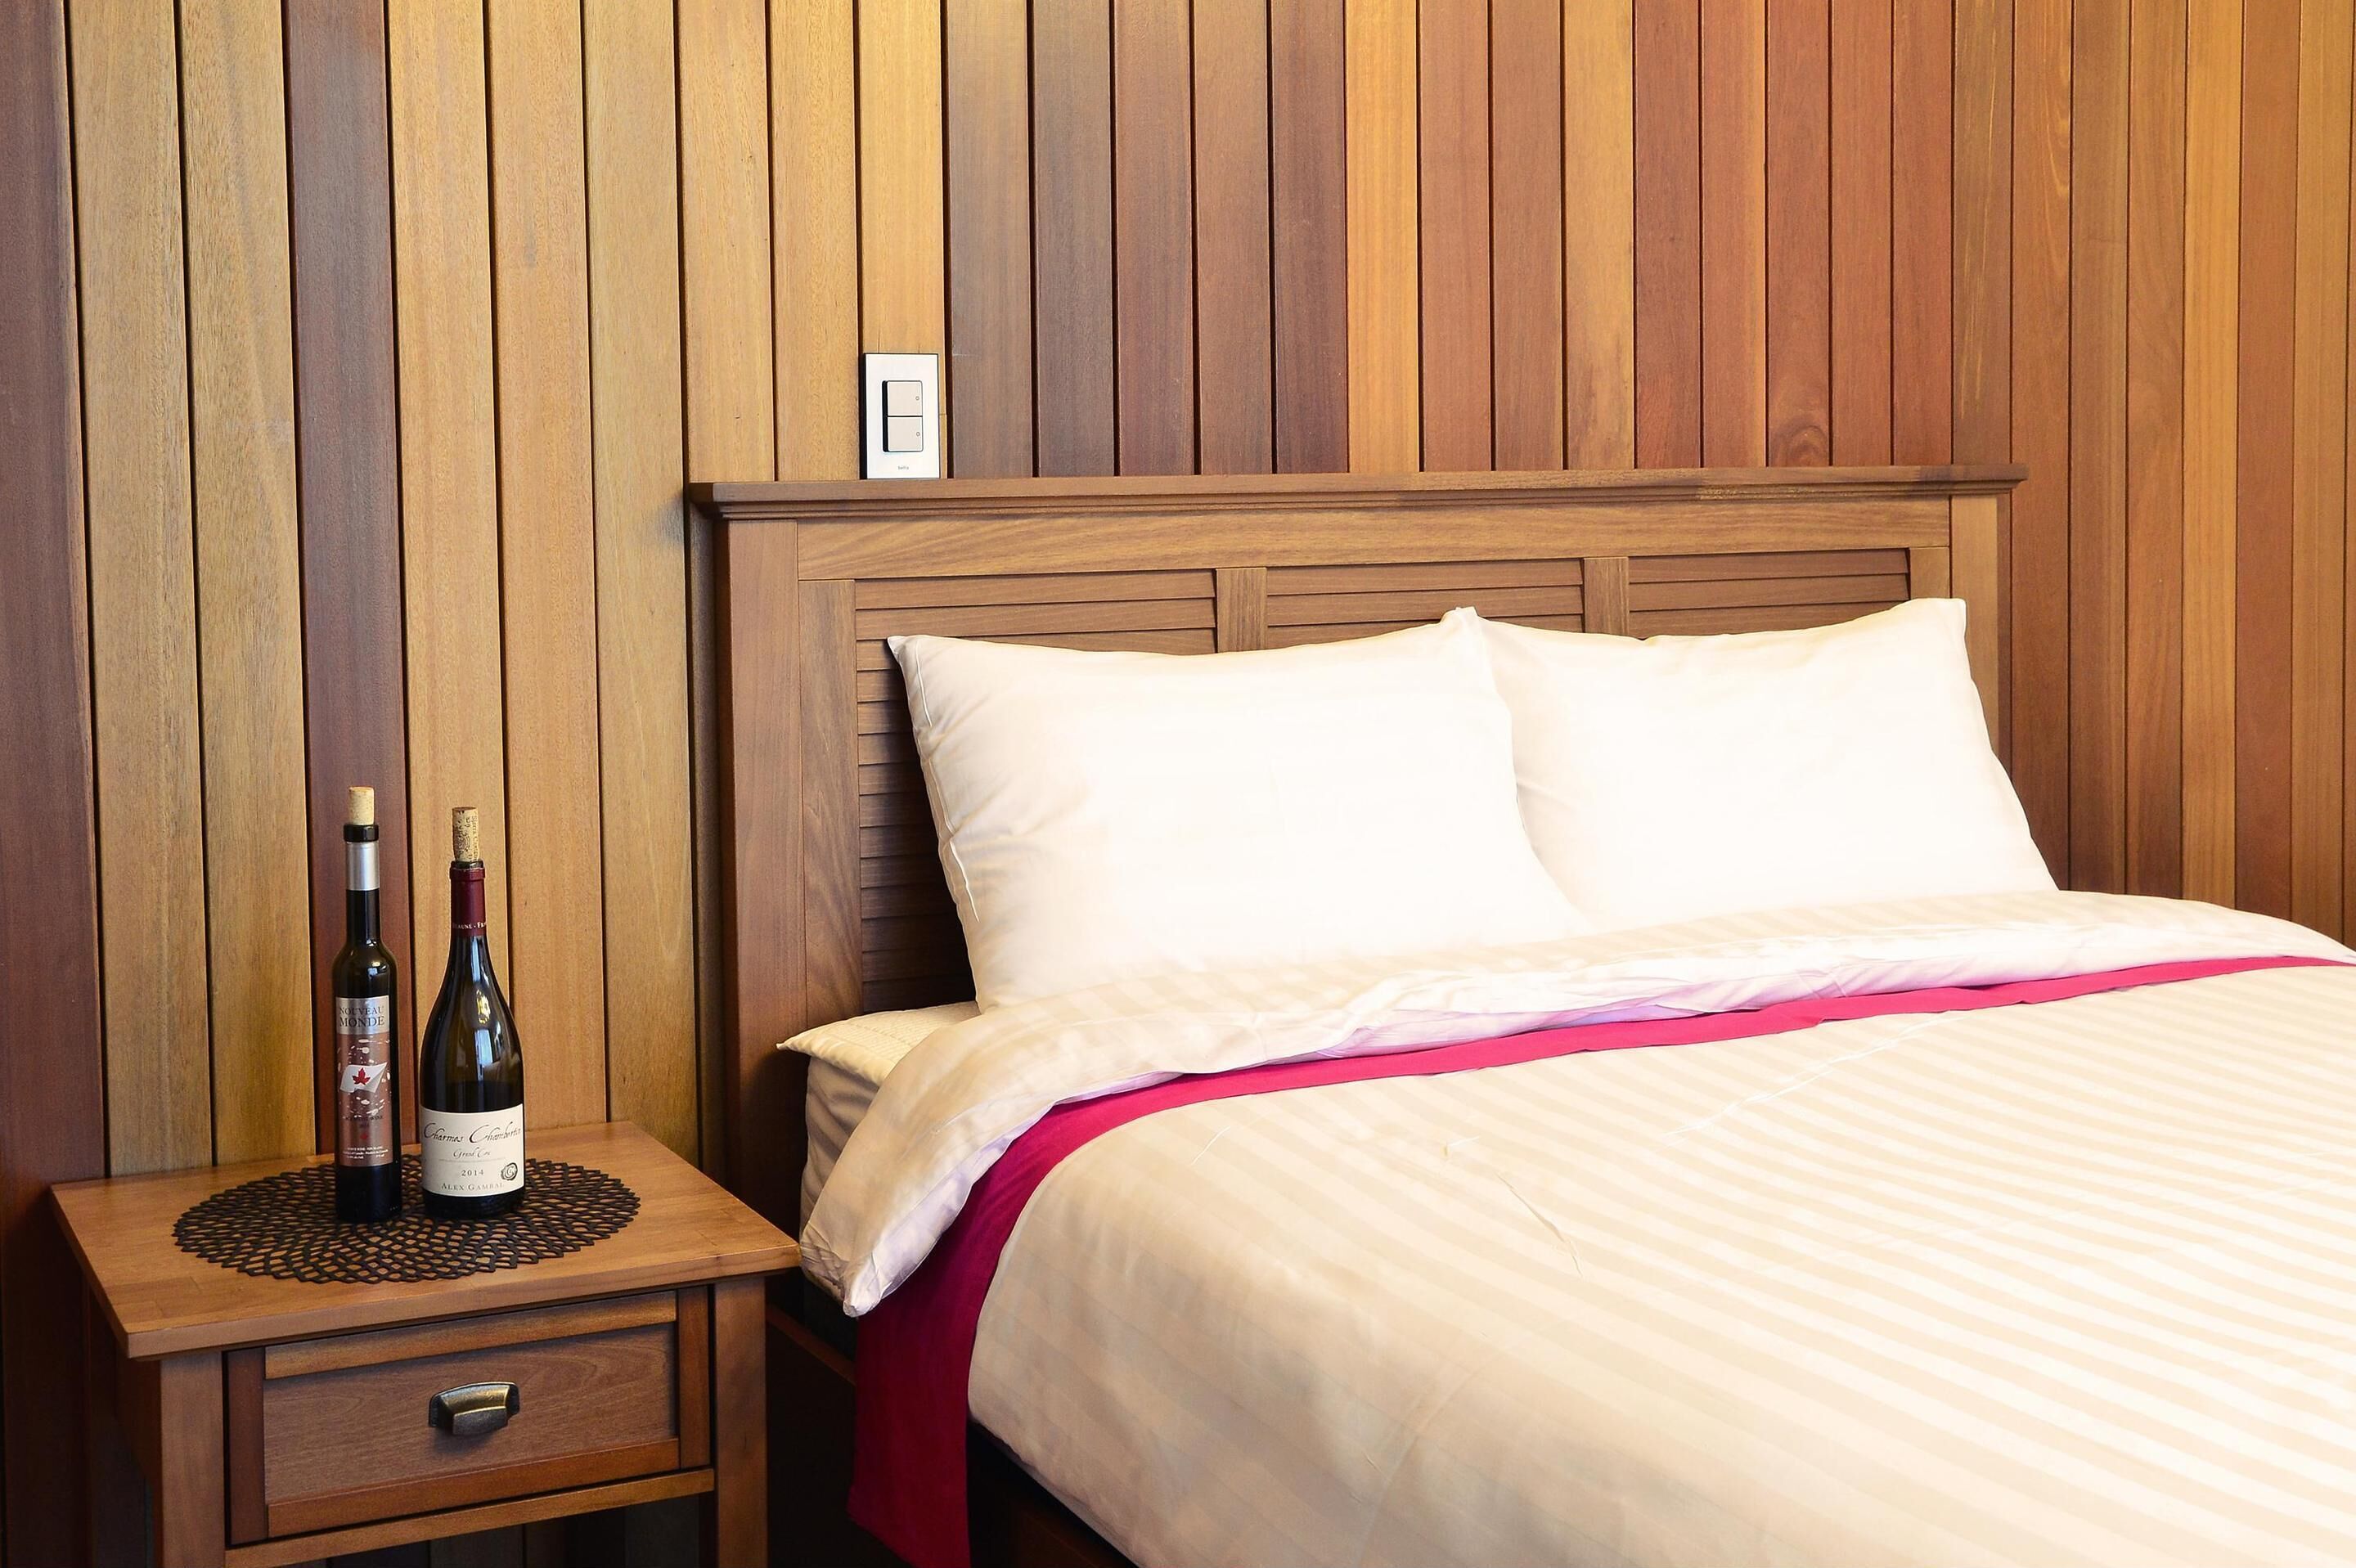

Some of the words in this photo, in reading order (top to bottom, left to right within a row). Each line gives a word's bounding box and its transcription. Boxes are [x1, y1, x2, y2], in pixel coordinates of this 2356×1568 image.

[339, 1005, 384, 1015] NOUVEAU
[339, 1015, 385, 1028] MONDE
[424, 1122, 464, 1143] Charmes
[452, 1147, 480, 1159] Grand
[461, 1169, 484, 1177] 2014
[441, 1183, 465, 1191] ALEX
